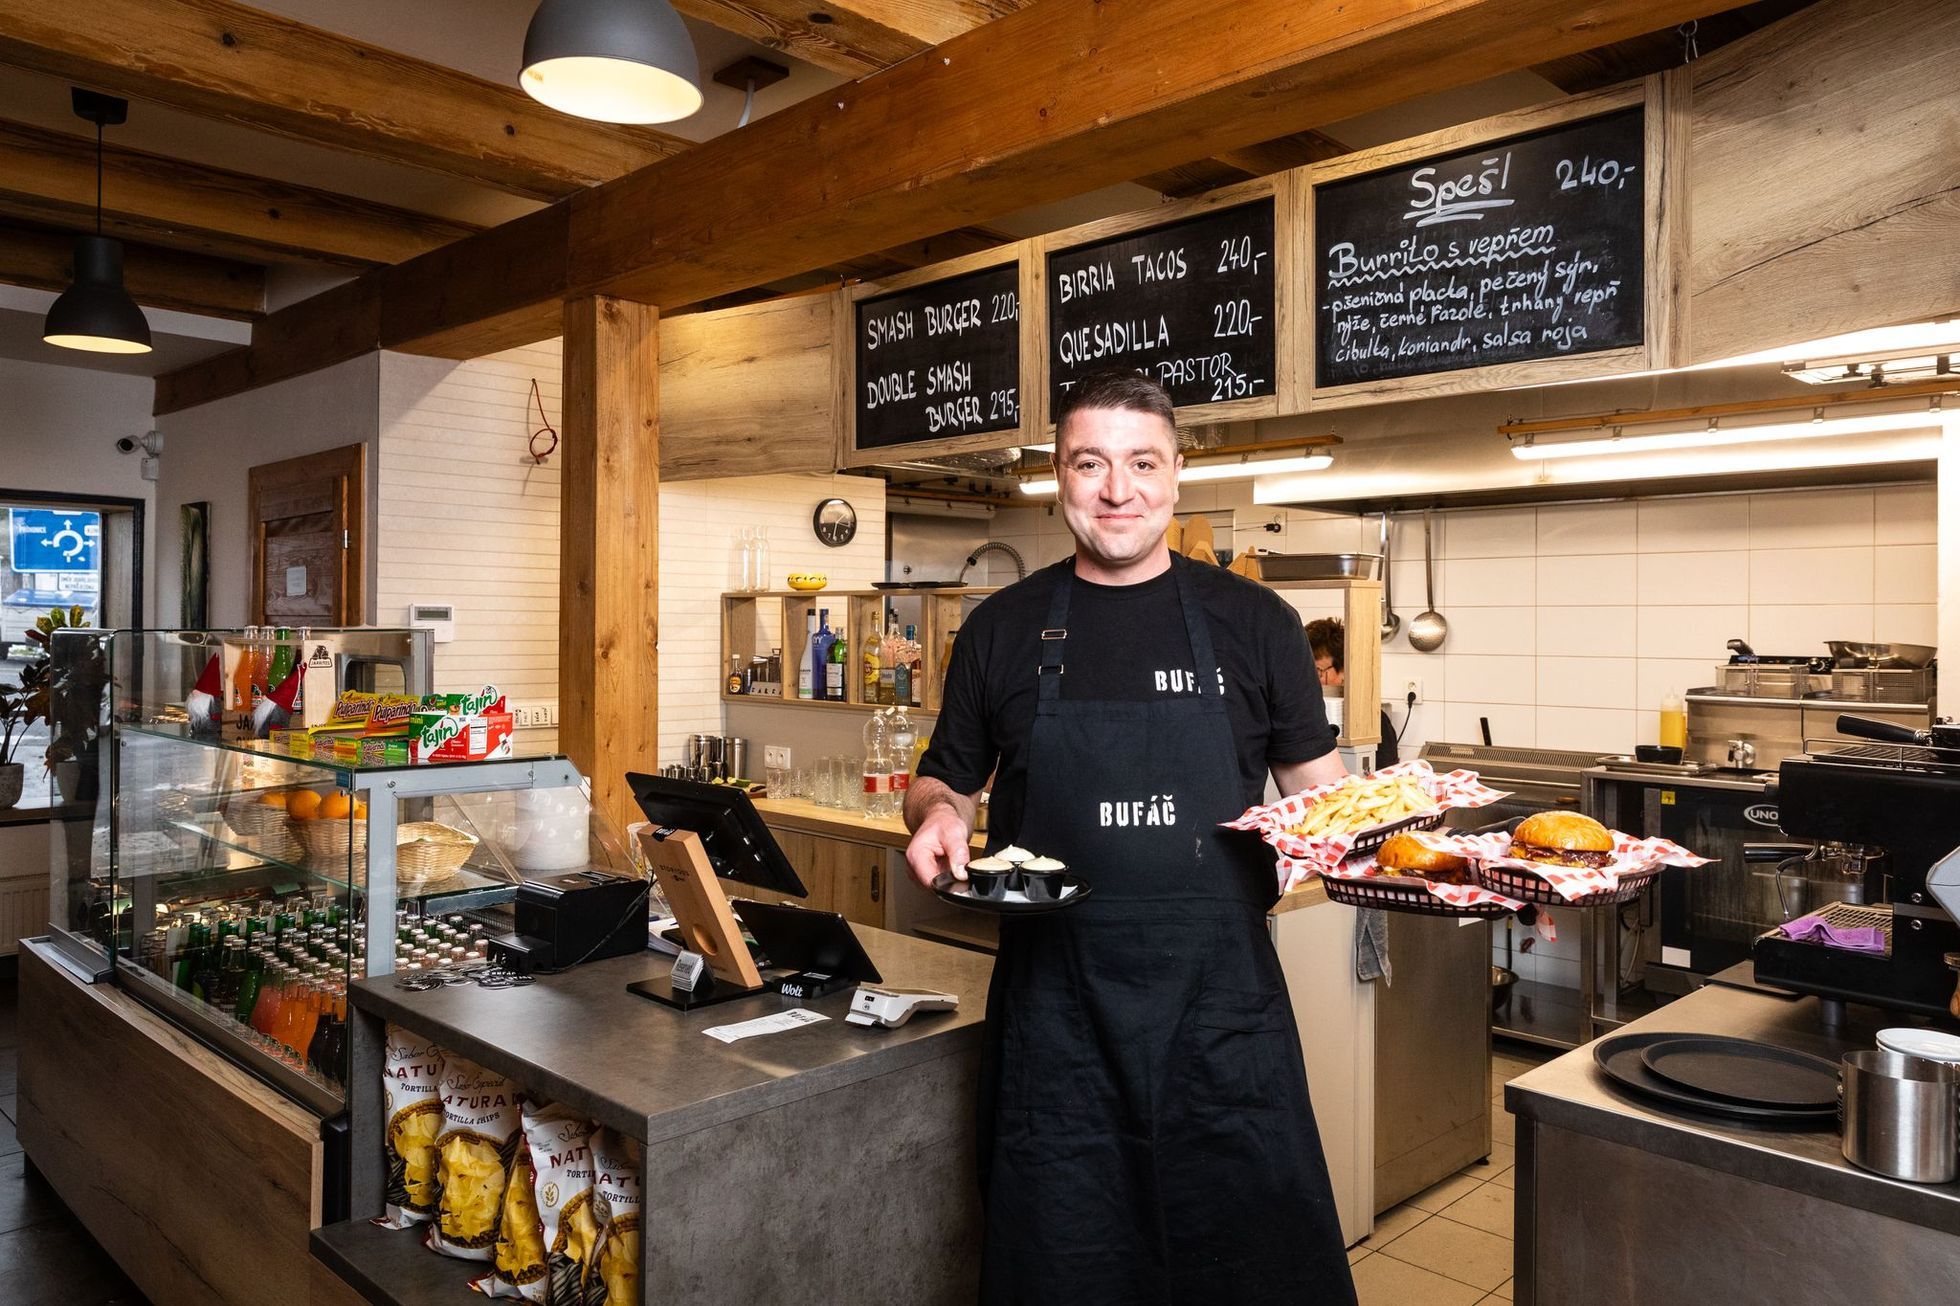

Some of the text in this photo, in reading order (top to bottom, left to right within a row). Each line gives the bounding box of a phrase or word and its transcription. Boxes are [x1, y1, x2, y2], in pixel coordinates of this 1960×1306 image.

[1409, 151, 1636, 215] Spešl 240,-
[1328, 224, 1555, 280] Burrito s vepřem
[1058, 235, 1268, 305] BIRRIA TACOS 240,-
[867, 310, 914, 350] SMASH
[924, 298, 982, 337] BURGER
[1059, 299, 1263, 370] QUESADILLA 220,-
[1482, 321, 1532, 349] salsa
[866, 360, 972, 410] DOUBLE SMASH
[1155, 351, 1238, 388] PASTOR
[1210, 373, 1265, 402] 215,-
[925, 395, 983, 433] BURGER
[1154, 667, 1225, 696] BUF
[1099, 794, 1177, 827] BUFÁČ
[1750, 809, 1779, 820] UNO
[781, 982, 804, 997] Wolt
[383, 1063, 438, 1079] NATU
[440, 1093, 517, 1109] ATURA
[550, 1145, 588, 1169] NAT
[602, 1190, 640, 1204] TORTILL
